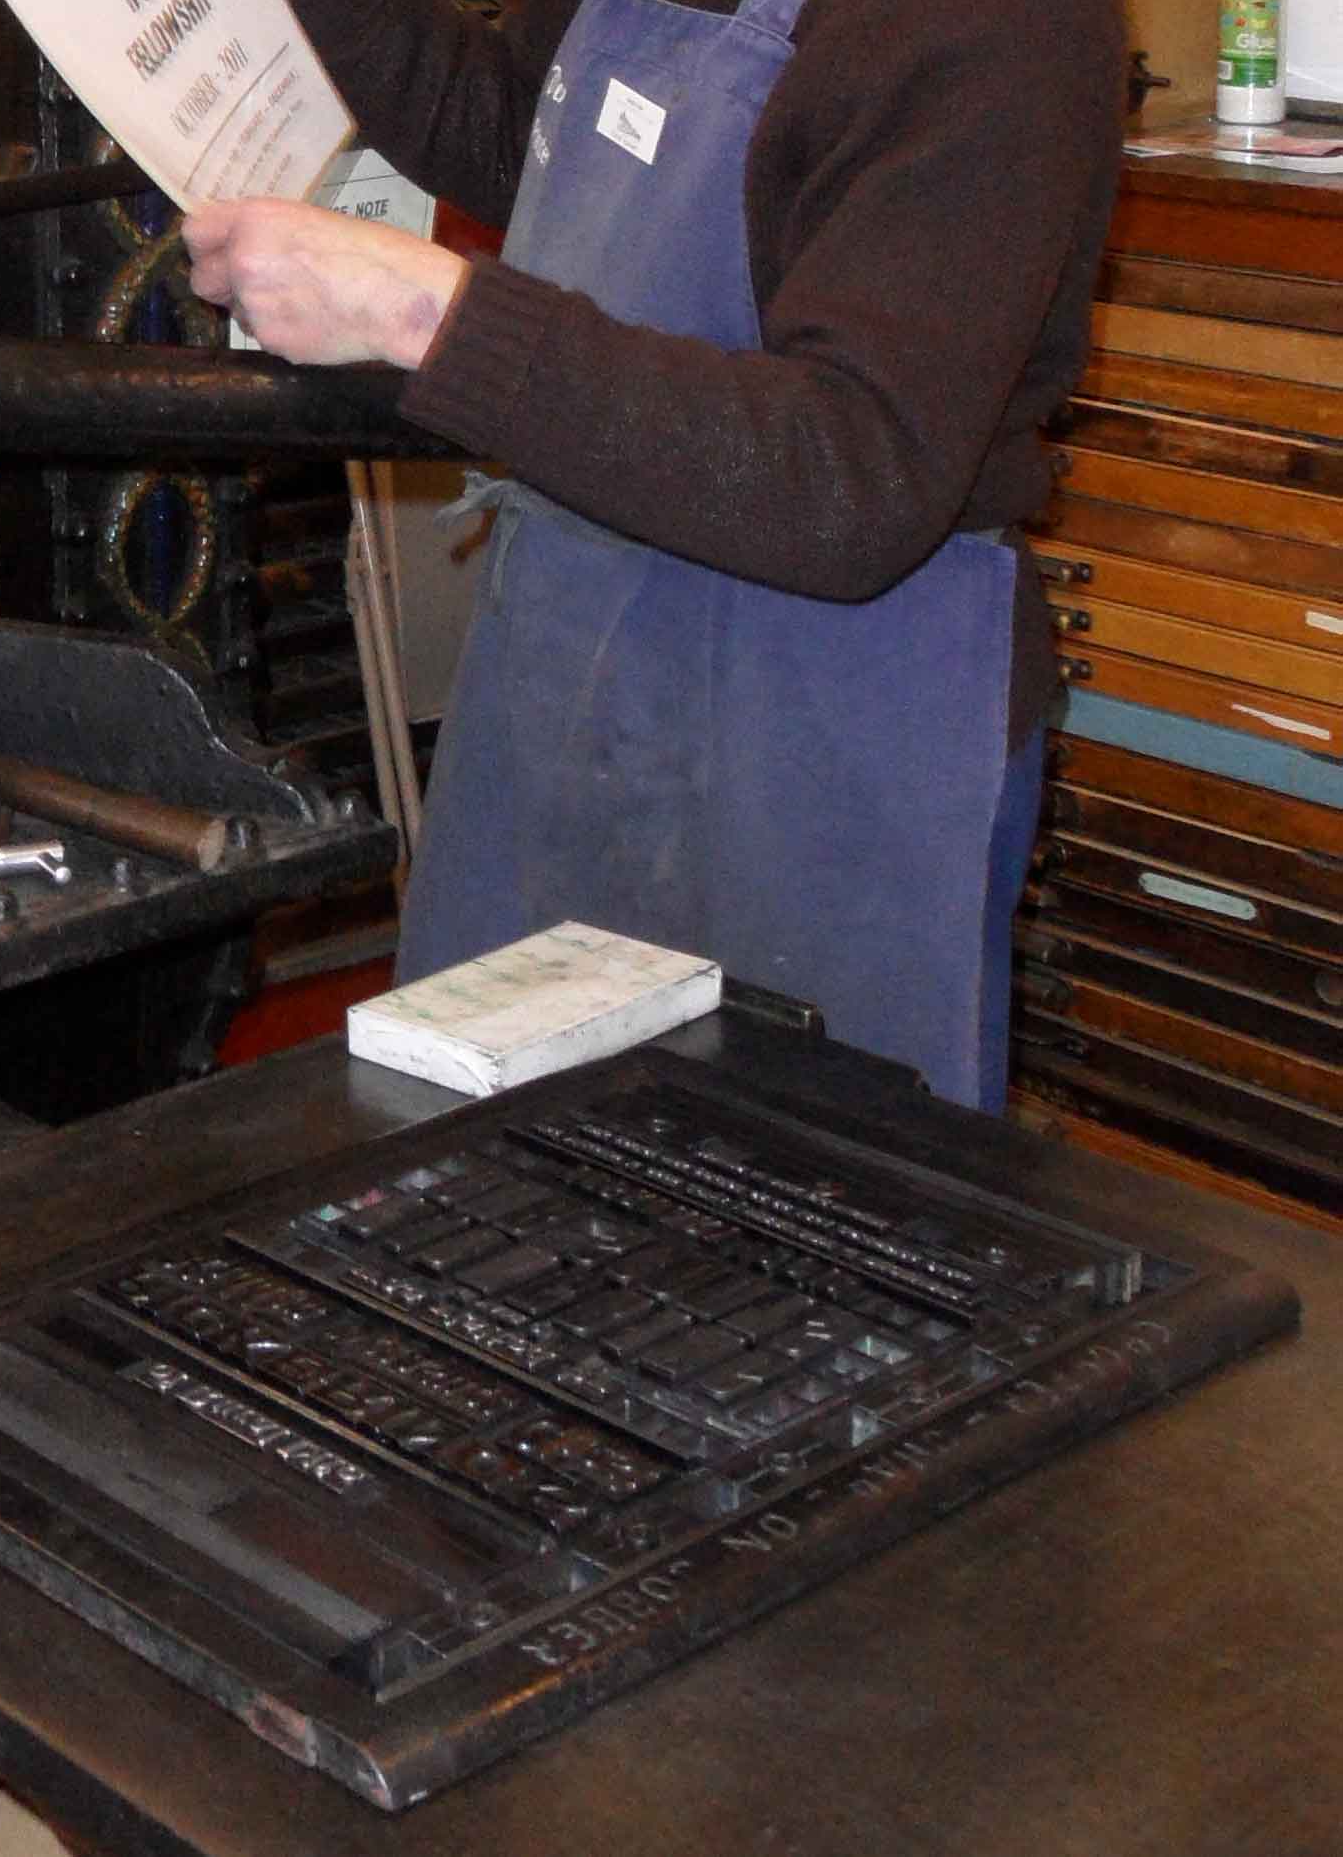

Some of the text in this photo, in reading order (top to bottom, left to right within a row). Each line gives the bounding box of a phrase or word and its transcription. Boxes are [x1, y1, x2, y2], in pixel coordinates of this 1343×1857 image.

[1235, 32, 1278, 50] Glue
[216, 37, 250, 82] 2011
[355, 198, 390, 217] NOTE
